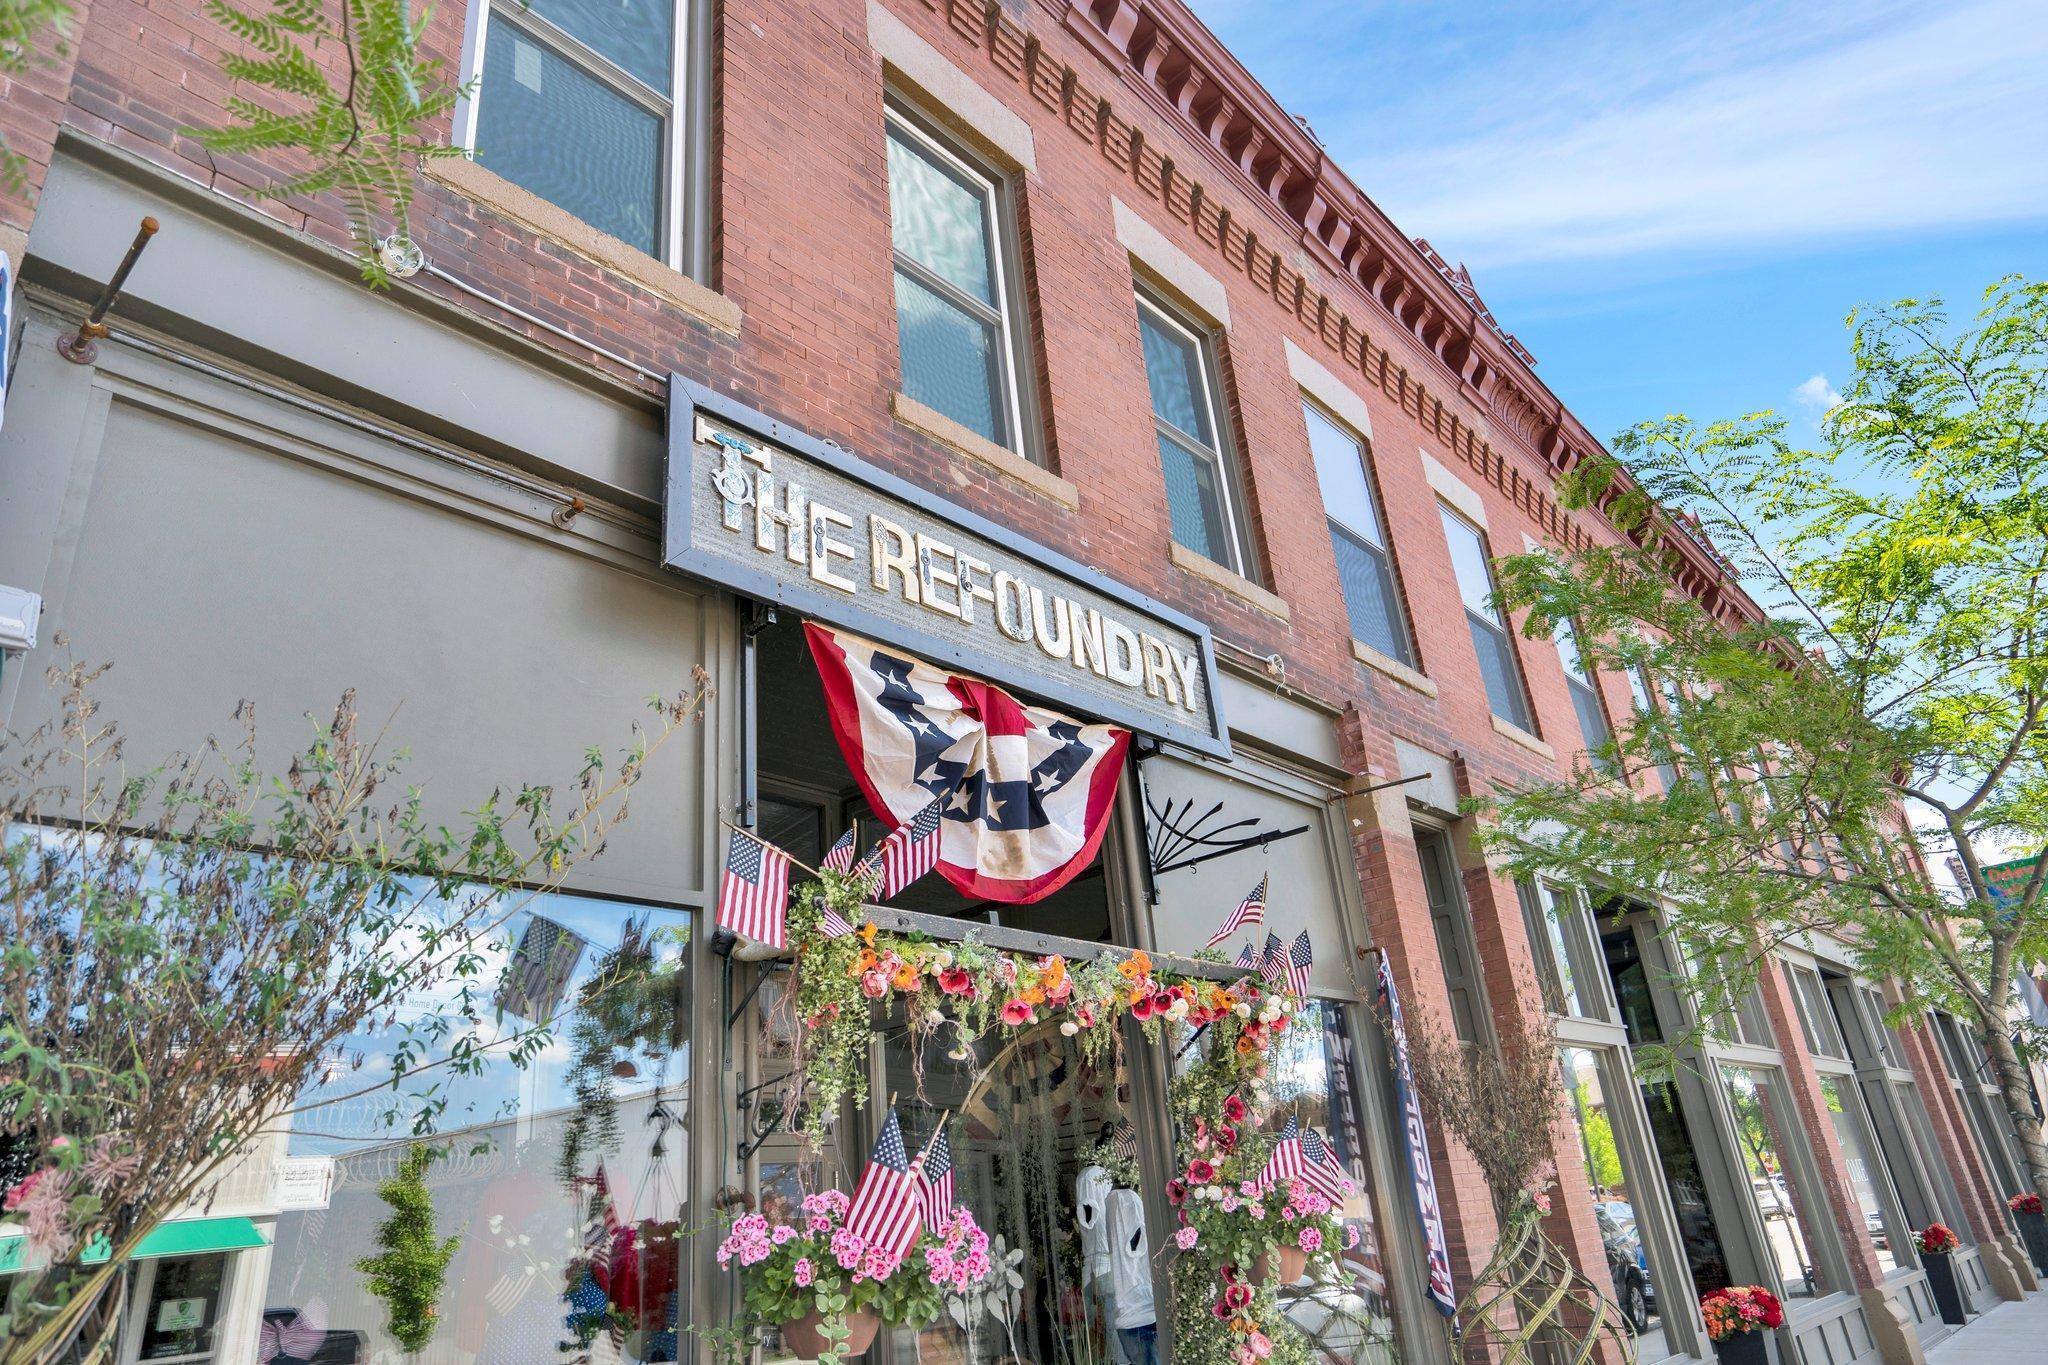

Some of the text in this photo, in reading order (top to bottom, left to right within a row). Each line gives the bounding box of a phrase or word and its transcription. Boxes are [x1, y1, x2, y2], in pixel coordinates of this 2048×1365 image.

[694, 415, 1199, 713] THE REFOUNDRY
[433, 999, 455, 1010] Dcor
